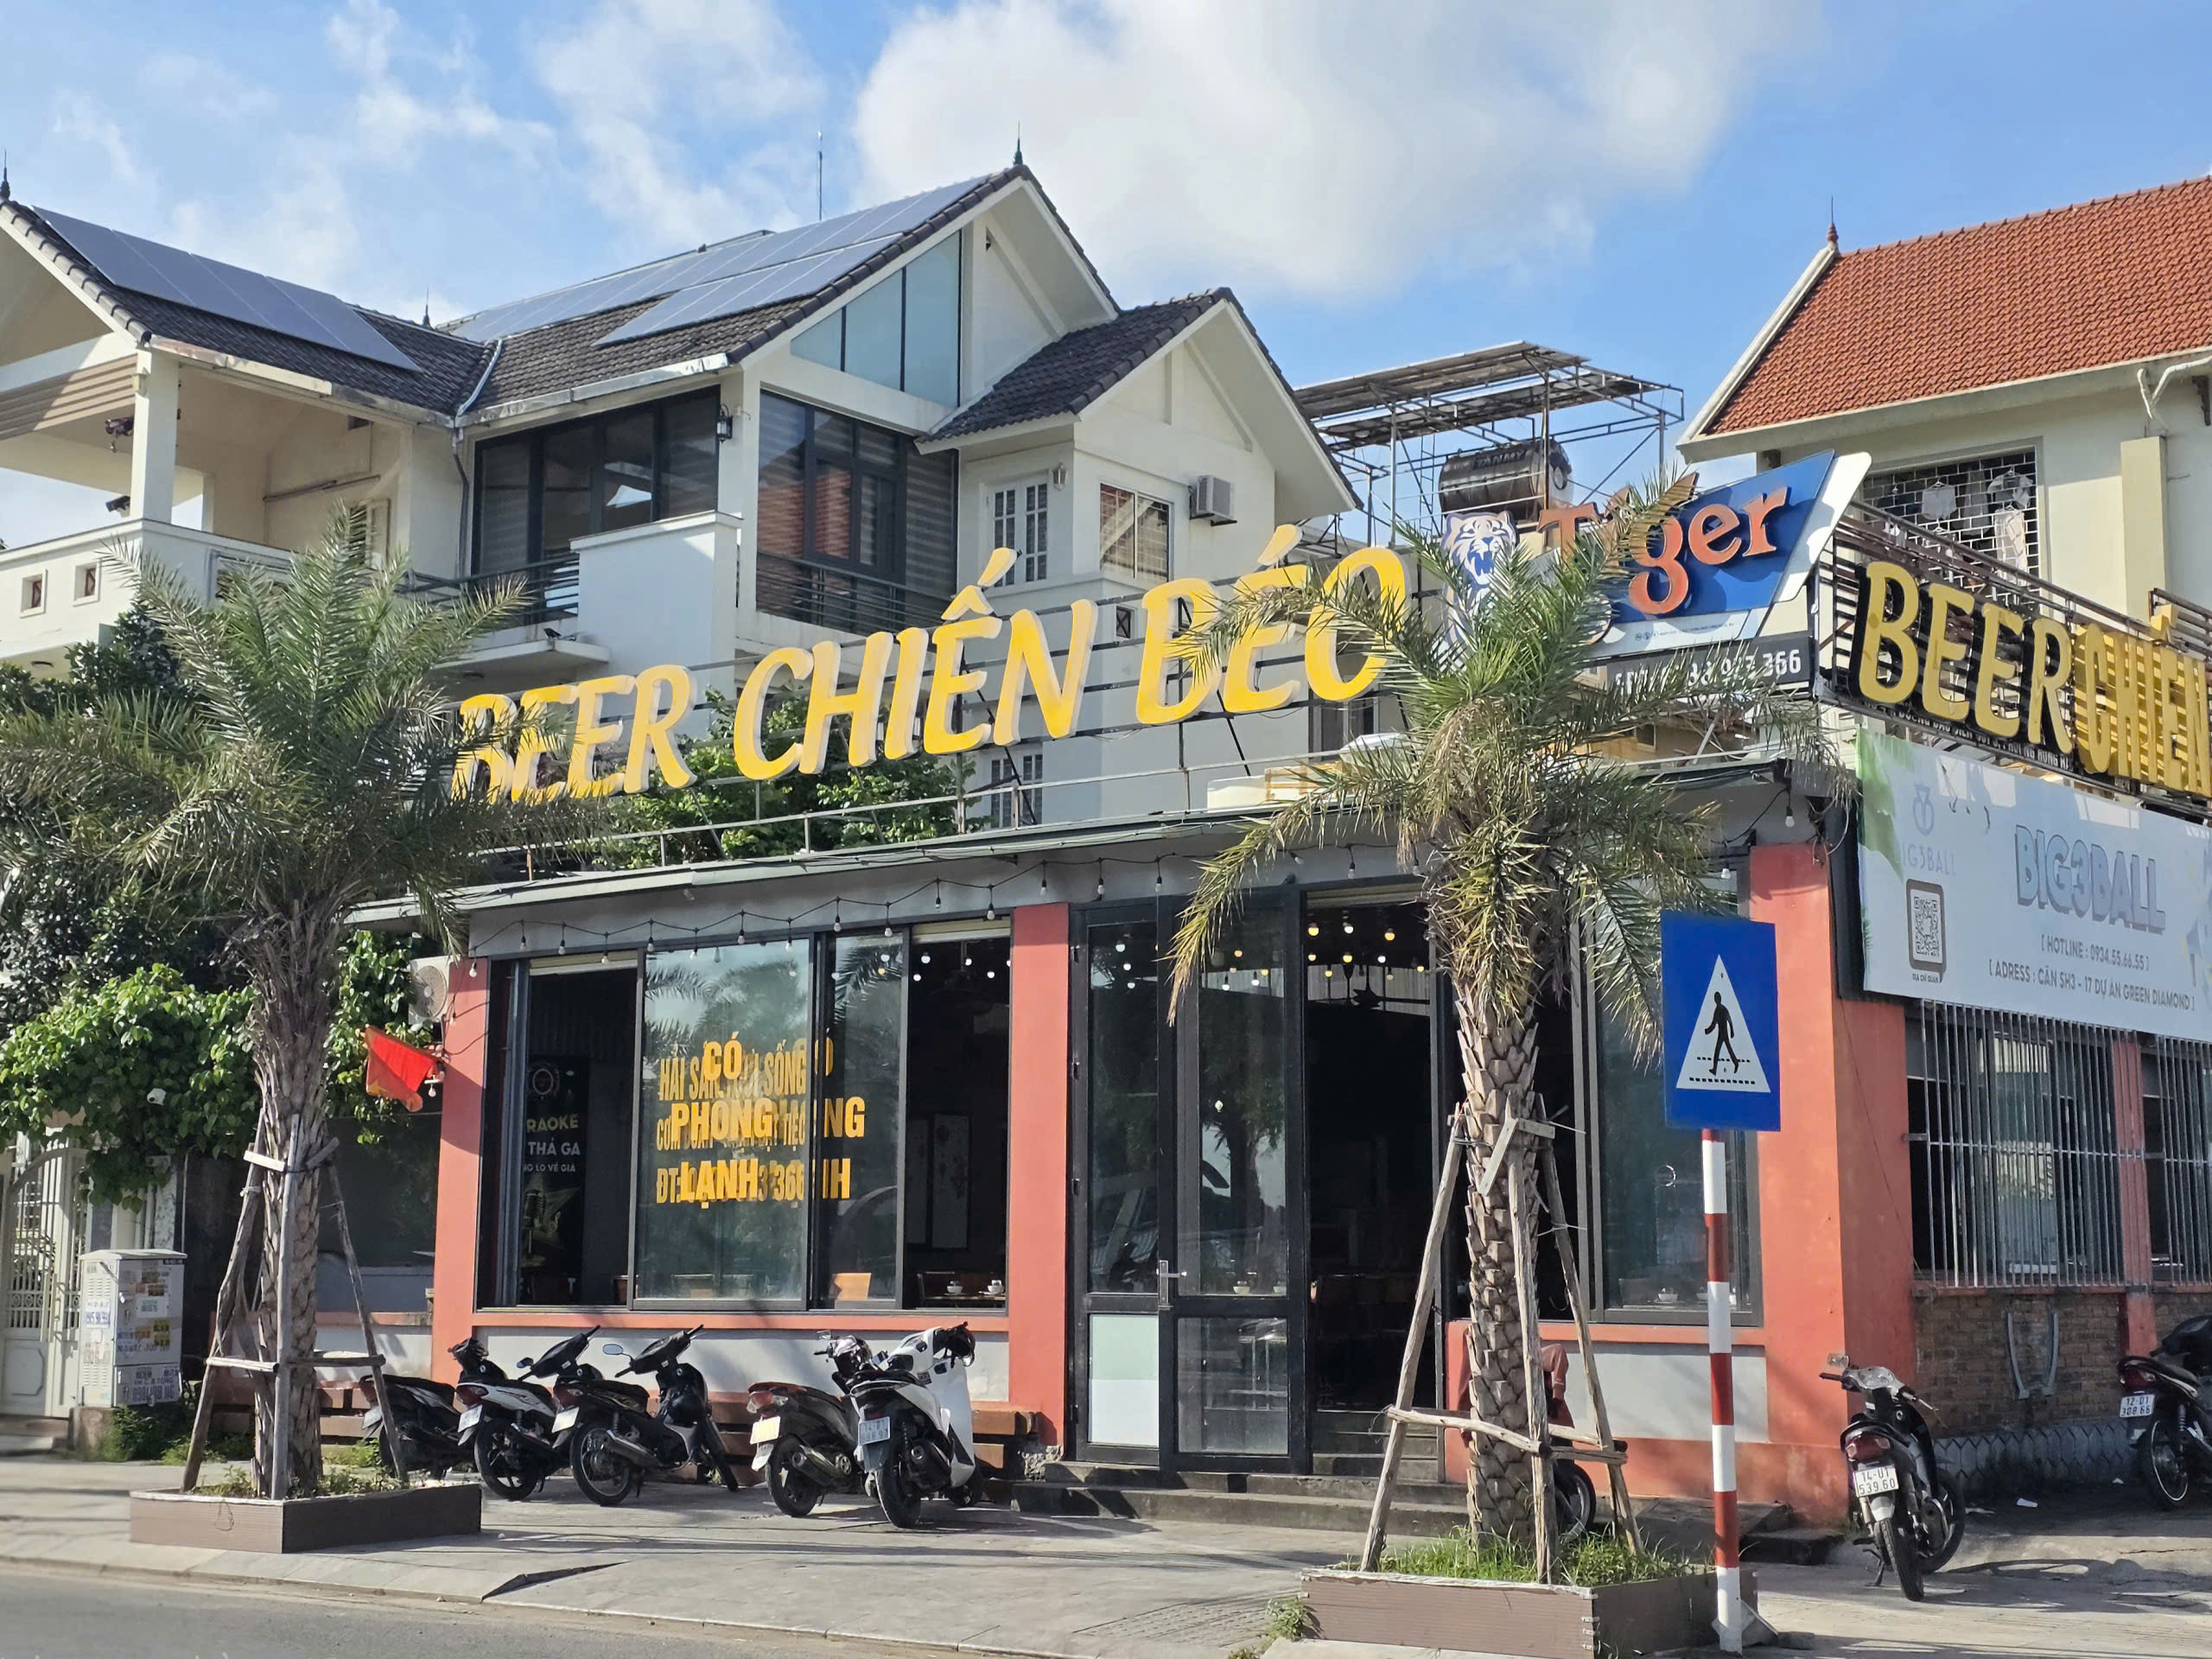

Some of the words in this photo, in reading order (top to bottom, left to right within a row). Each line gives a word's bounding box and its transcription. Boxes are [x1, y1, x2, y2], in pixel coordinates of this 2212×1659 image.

[450, 664, 697, 807] BEER
[734, 546, 1098, 779] CHIẾN
[1135, 524, 1411, 725] BÉO
[1857, 560, 2073, 754] BEER
[2014, 823, 2166, 935] BIG3BALL
[2047, 935, 2083, 959] HOTLINE
[2090, 944, 2145, 970] 0934.55.66.55
[1995, 961, 2031, 983] ADRESS
[2084, 976, 2093, 994] 17
[2123, 983, 2150, 1004] GREEN
[2152, 989, 2190, 1010] DIAMOND
[703, 1031, 742, 1080] CÓ
[526, 1113, 579, 1135] RAOKE
[561, 1141, 581, 1156] GA
[680, 1158, 759, 1209] LẠNH
[1859, 1478, 1896, 1496] 539.60
